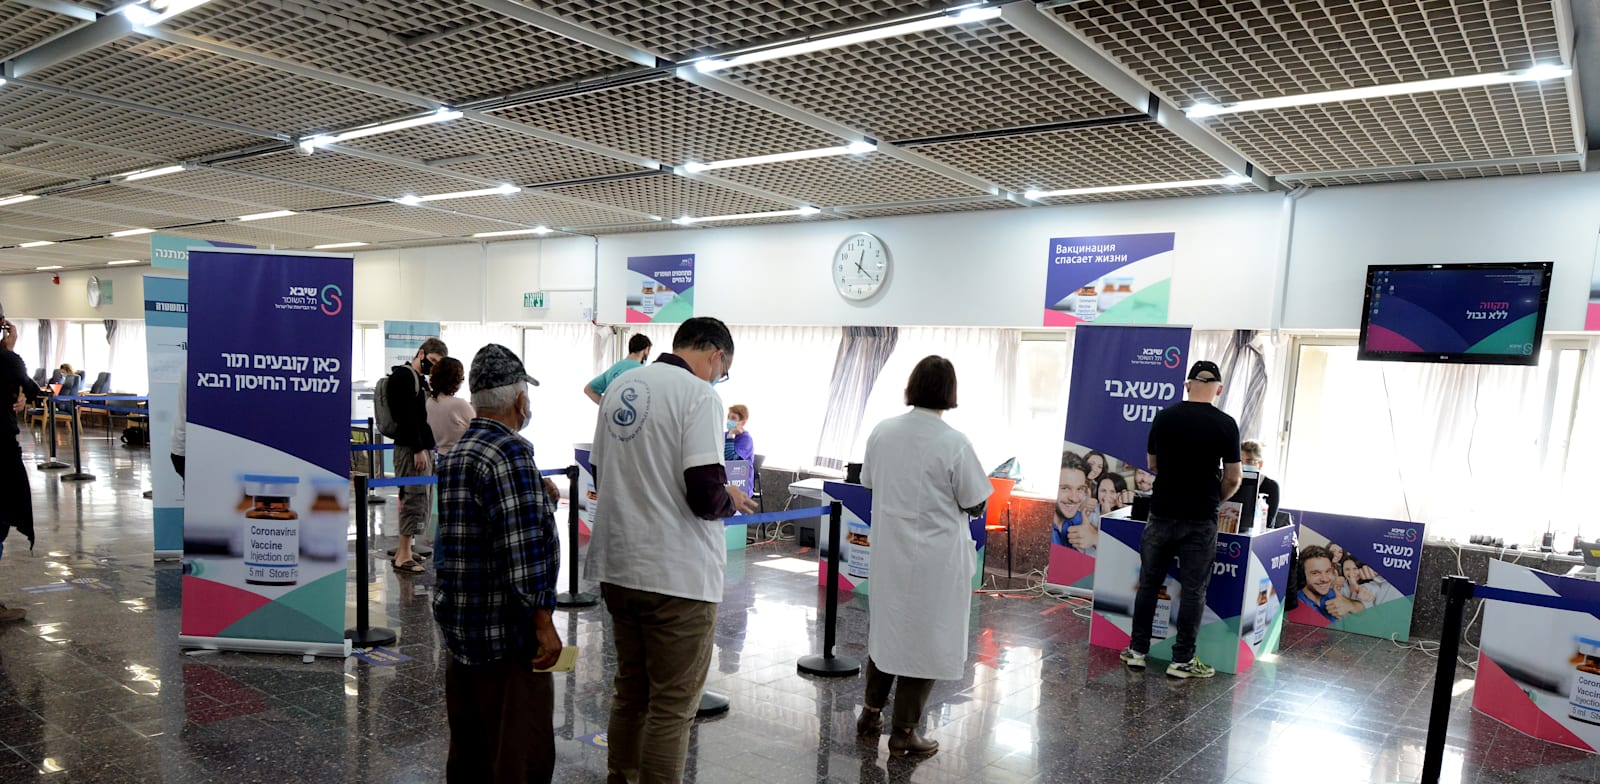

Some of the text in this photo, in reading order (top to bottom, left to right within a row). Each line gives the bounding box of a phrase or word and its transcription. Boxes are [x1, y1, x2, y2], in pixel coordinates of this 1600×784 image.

[848, 243, 854, 251] 11
[1056, 244, 1116, 255] Вакцинация
[841, 252, 849, 261] 10
[1055, 254, 1128, 265] спасает жизни
[289, 286, 317, 297] שיבא
[281, 296, 317, 305] תל השומר
[1480, 302, 1509, 310] תקווה
[1466, 310, 1508, 320] ללא גבול
[221, 352, 340, 374] כאן קובעים תור
[197, 372, 340, 393] למועד החיסון הבא
[1104, 379, 1175, 401] משאבי
[250, 525, 297, 536] Coronavirus
[250, 538, 283, 550] Vaccine
[1372, 543, 1414, 557] משאבי
[250, 551, 282, 562] Injection
[1382, 557, 1412, 570] אנוש
[249, 567, 254, 577] 5
[254, 568, 264, 577] ml
[268, 569, 290, 578] Store
[1212, 561, 1239, 578] זימ
[1572, 706, 1577, 714] 5
[1577, 709, 1586, 717] ml
